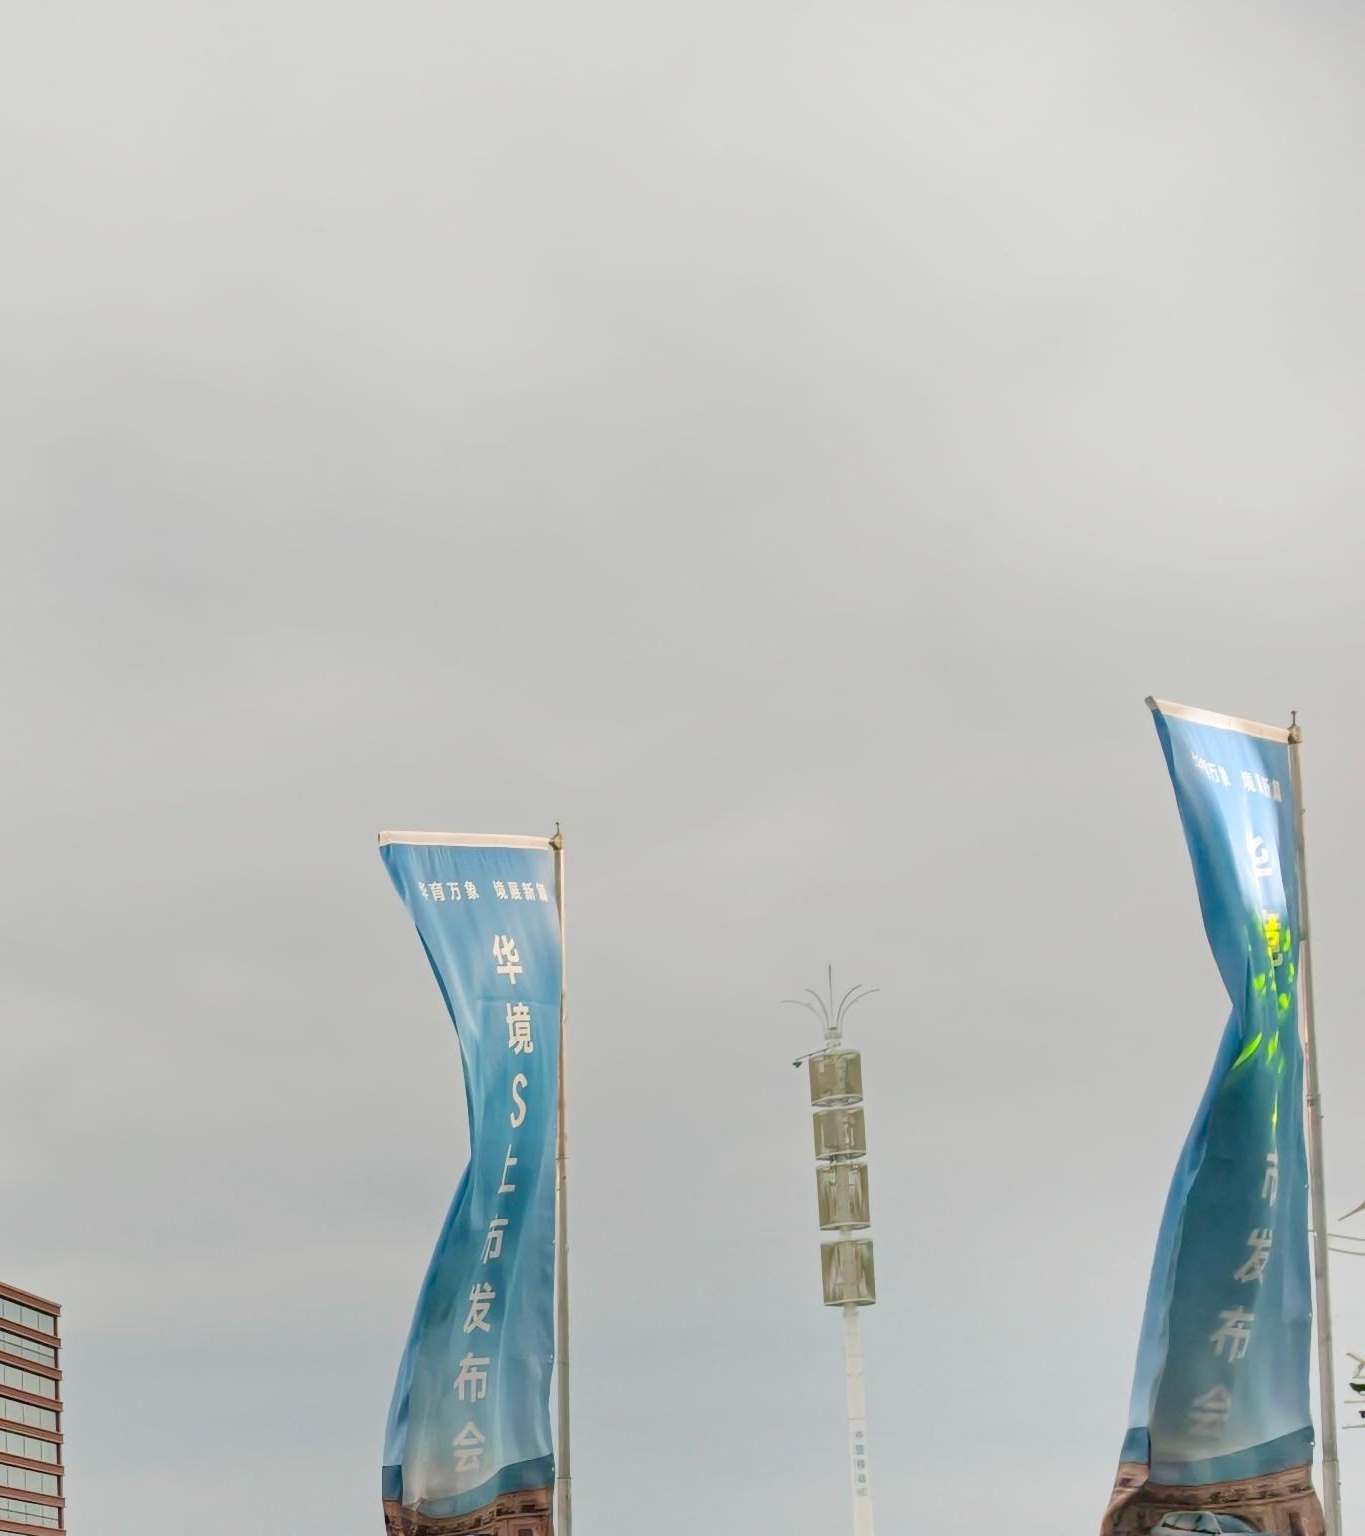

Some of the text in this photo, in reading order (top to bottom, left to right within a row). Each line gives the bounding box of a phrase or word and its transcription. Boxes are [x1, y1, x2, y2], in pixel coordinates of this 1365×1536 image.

[452, 933, 534, 1473] 华境S上市发布会
